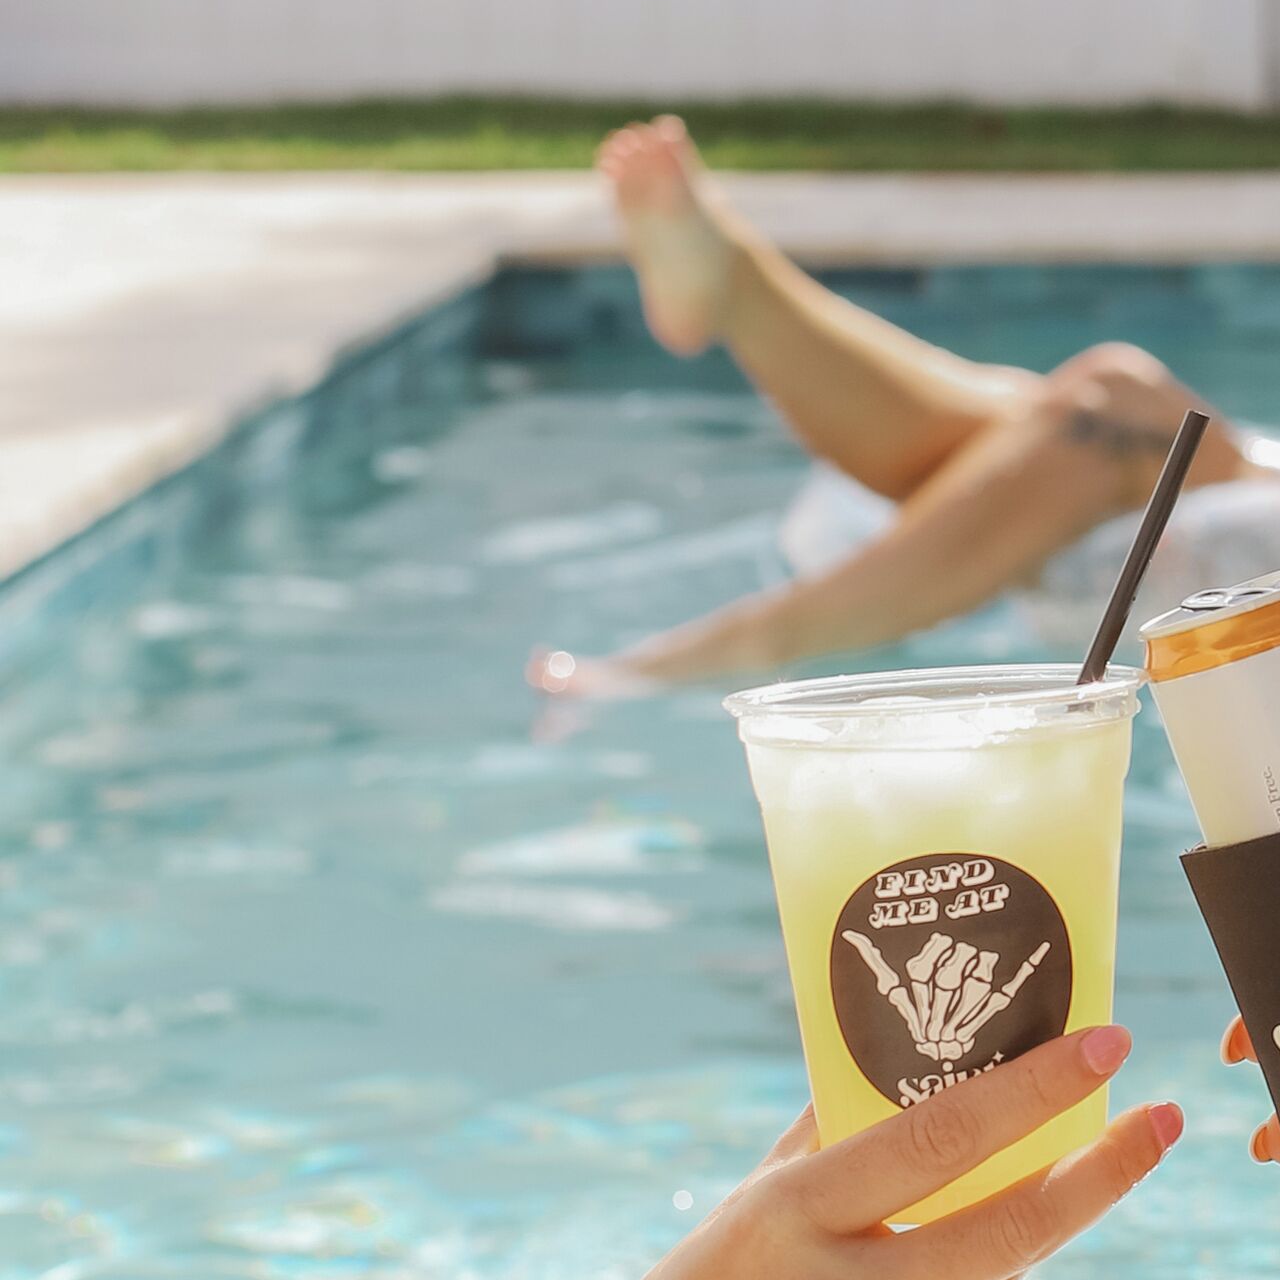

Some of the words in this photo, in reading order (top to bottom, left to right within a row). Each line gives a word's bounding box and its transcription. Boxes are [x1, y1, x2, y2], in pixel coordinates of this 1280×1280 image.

[875, 859, 994, 898] FIND
[869, 897, 939, 929] ME
[945, 884, 1009, 919] AT
